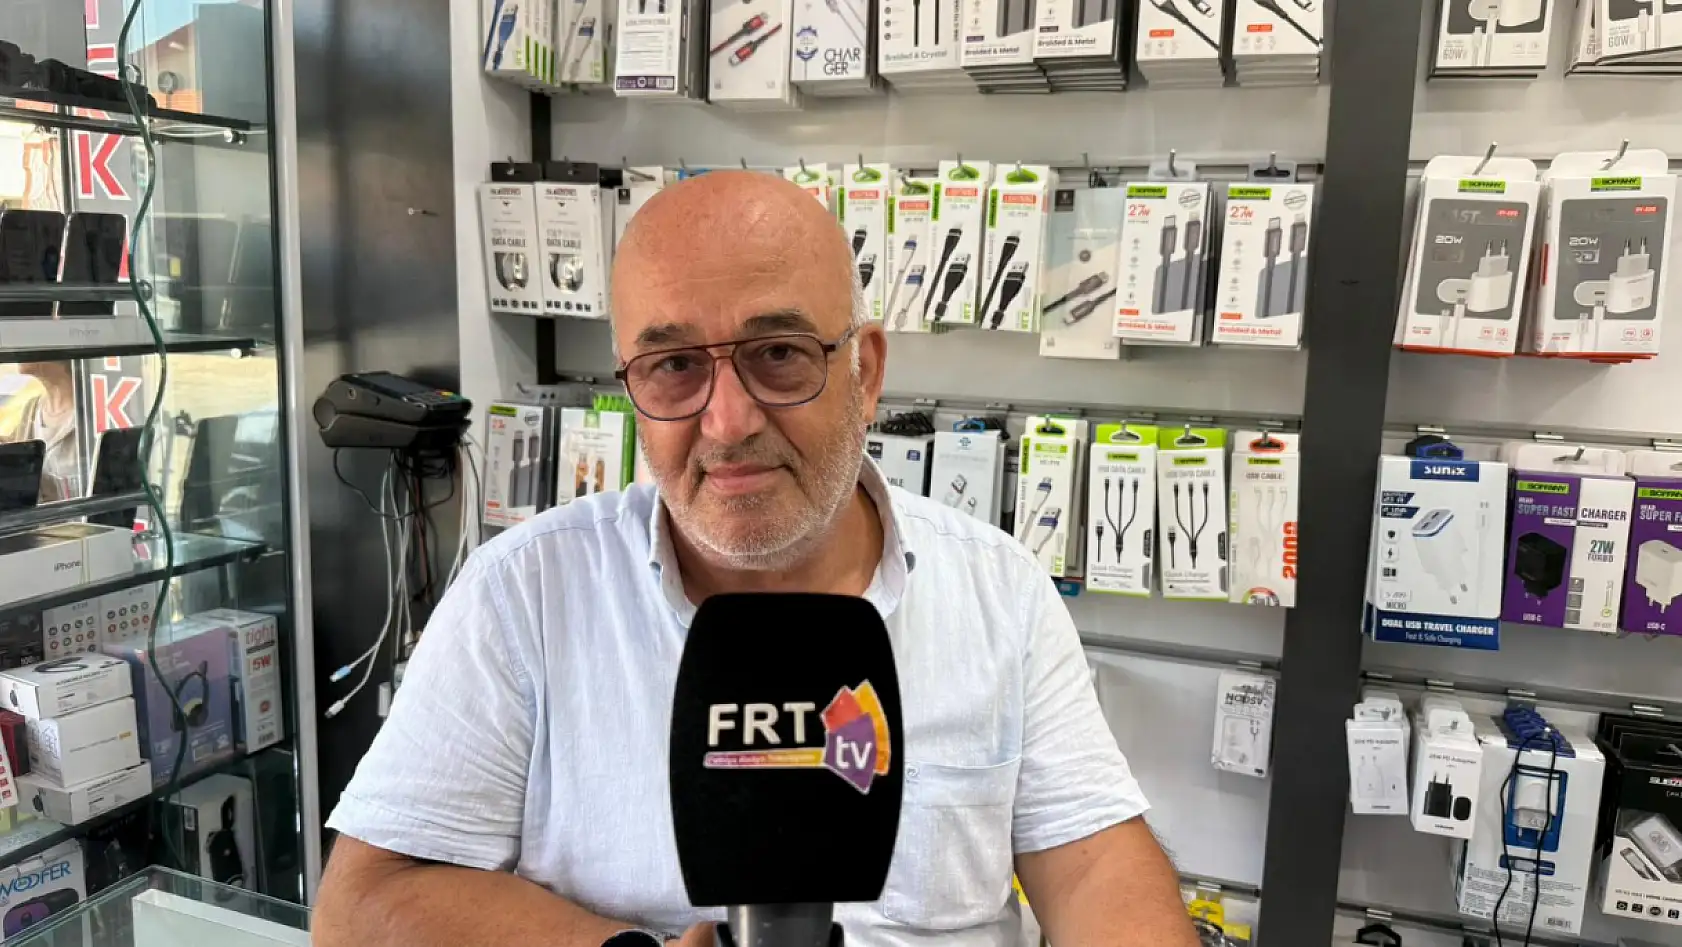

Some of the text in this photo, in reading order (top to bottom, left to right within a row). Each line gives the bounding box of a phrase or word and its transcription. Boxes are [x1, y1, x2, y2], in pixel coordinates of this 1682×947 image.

[824, 48, 861, 62] CHAR
[823, 62, 849, 75] GER
[1435, 235, 1463, 244] 20W
[1569, 236, 1599, 247] 20W
[1518, 504, 1627, 521] SUPER FAST CHARGER
[1639, 510, 1672, 522] SUPER
[1590, 539, 1615, 554] 27W
[54, 560, 81, 572] iPhone
[1381, 618, 1495, 636] DUAL USB TRAVEL CHARGER
[708, 702, 816, 747] FRT
[836, 735, 873, 770] tv
